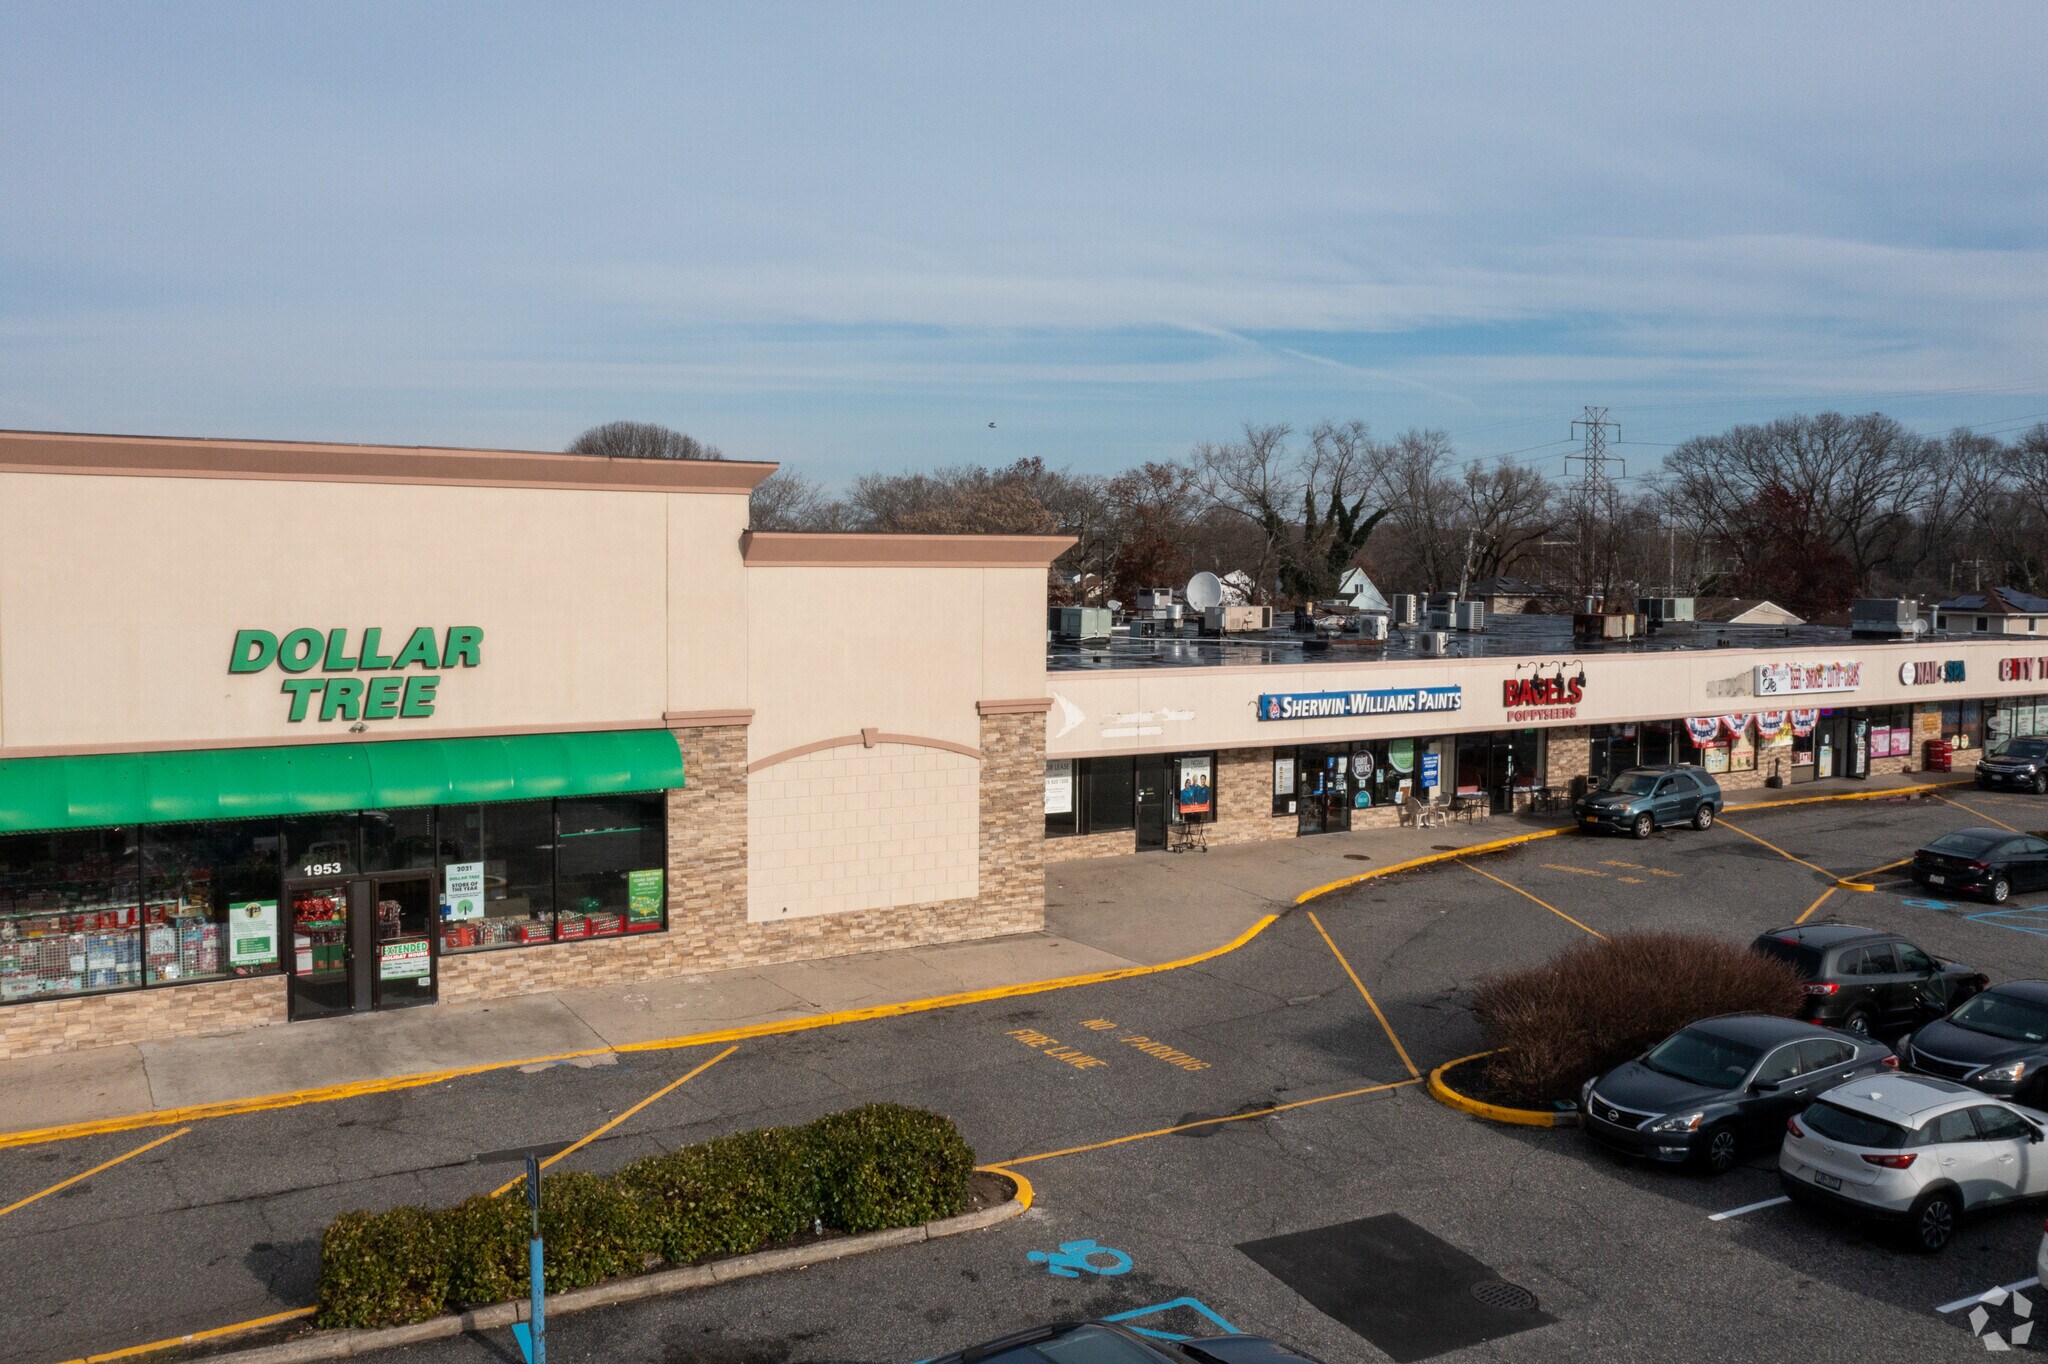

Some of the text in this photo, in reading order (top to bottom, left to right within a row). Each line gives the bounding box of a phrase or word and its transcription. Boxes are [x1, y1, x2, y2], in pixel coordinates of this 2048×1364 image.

[228, 626, 484, 674] DOLLAR
[1999, 657, 2035, 681] CITY
[281, 675, 440, 722] TREE
[1282, 690, 1461, 718] SHERWIN-WILLIAMS PAINTS
[1503, 677, 1583, 707] BAGELS
[1507, 707, 1576, 722] POPPYSEEDS
[1054, 762, 1070, 770] LEASE
[304, 862, 341, 876] 1953
[382, 941, 428, 956] EXTENDED
[1079, 1018, 1117, 1031] NO
[1005, 1028, 1109, 1070] FIRE LANE
[1120, 1036, 1211, 1071] PARKING
